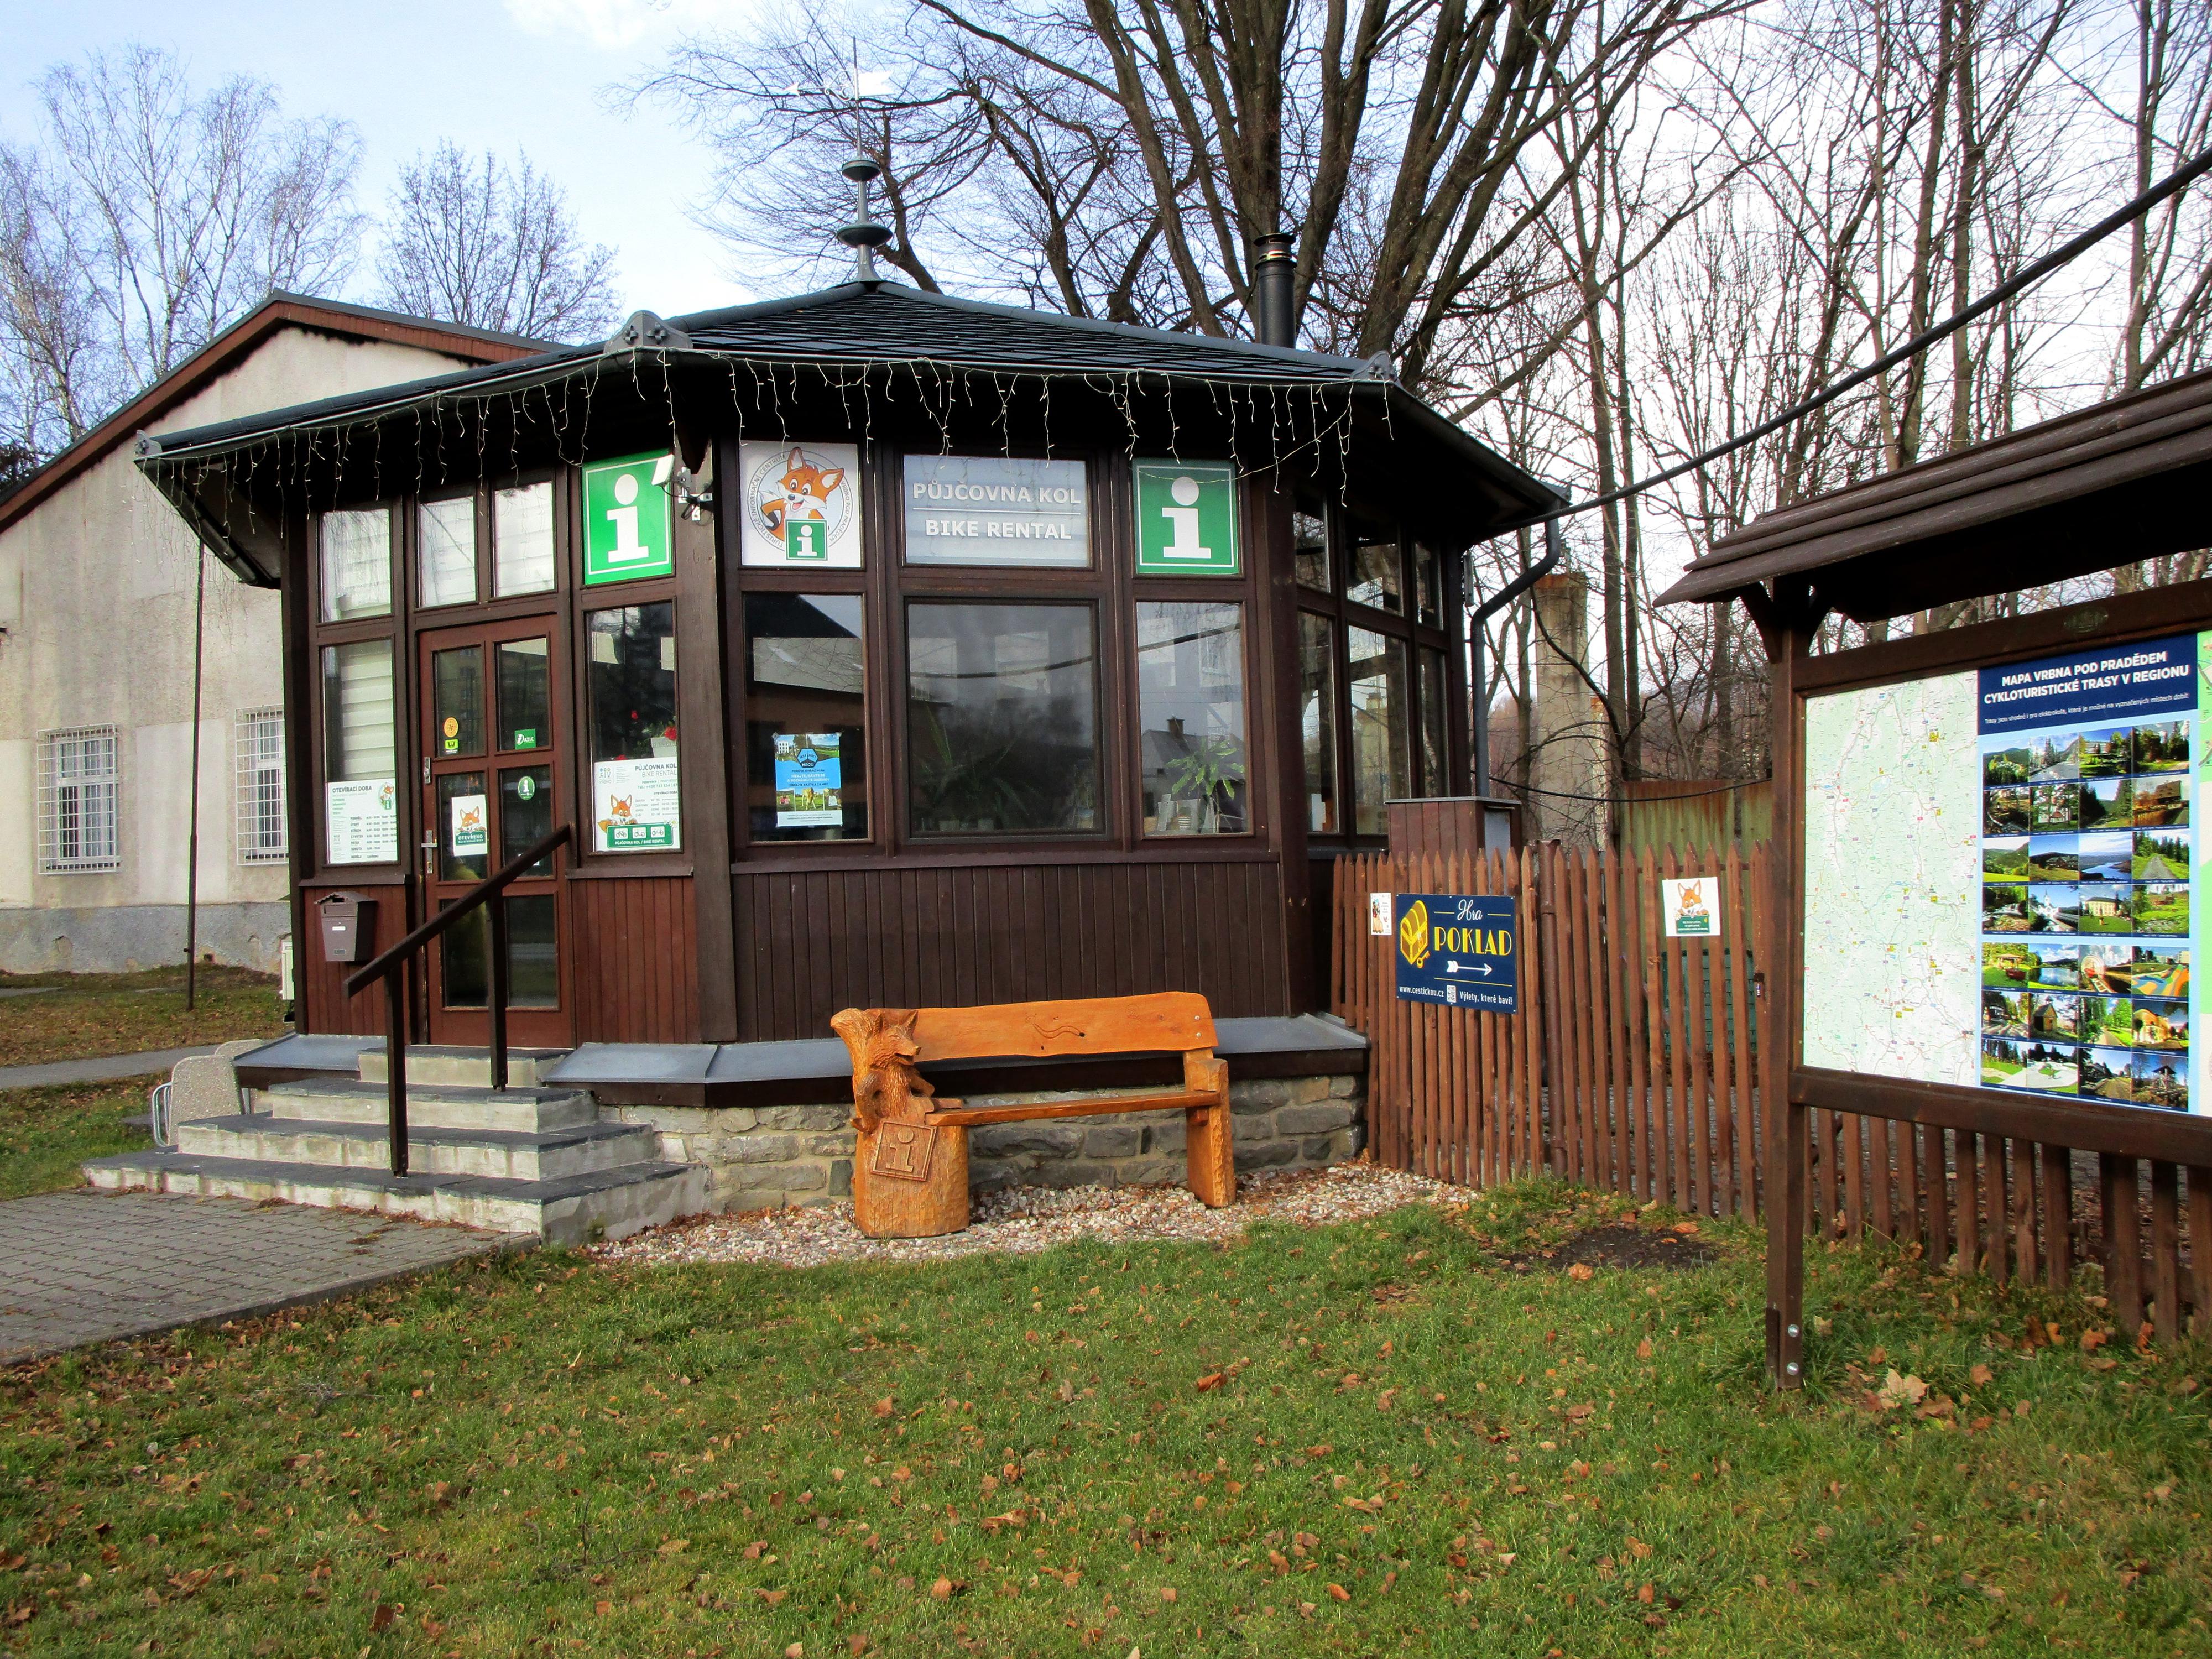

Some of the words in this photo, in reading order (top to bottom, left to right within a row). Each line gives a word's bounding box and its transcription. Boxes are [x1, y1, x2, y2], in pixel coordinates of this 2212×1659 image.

[760, 455, 787, 476] CENTRUM
[752, 476, 761, 517] INFORMAČNÍ
[841, 481, 850, 502] VRBNO
[913, 479, 1031, 503] PŮJČOVNA
[1039, 487, 1082, 504] KOL
[753, 518, 784, 547] TURISTICKÉ
[926, 519, 979, 537] BIKE
[987, 521, 1072, 539] RENTAL
[2002, 672, 2032, 686] MAPA
[2033, 666, 2073, 681] VRBNA
[2074, 662, 2098, 676] POD
[2100, 651, 2168, 671] PRADĚDEM
[1984, 679, 2080, 704] CYKLOTURISTICKÉ
[2081, 674, 2120, 690] TRASY
[2121, 674, 2132, 685] V
[2132, 665, 2190, 683] REGIONU
[1457, 899, 1483, 921] Hra
[1434, 926, 1512, 956] POKLAD
[1399, 985, 1444, 998] www.cestickou.cz
[1460, 990, 1479, 1003] Výlety,
[1481, 993, 1496, 1003] které
